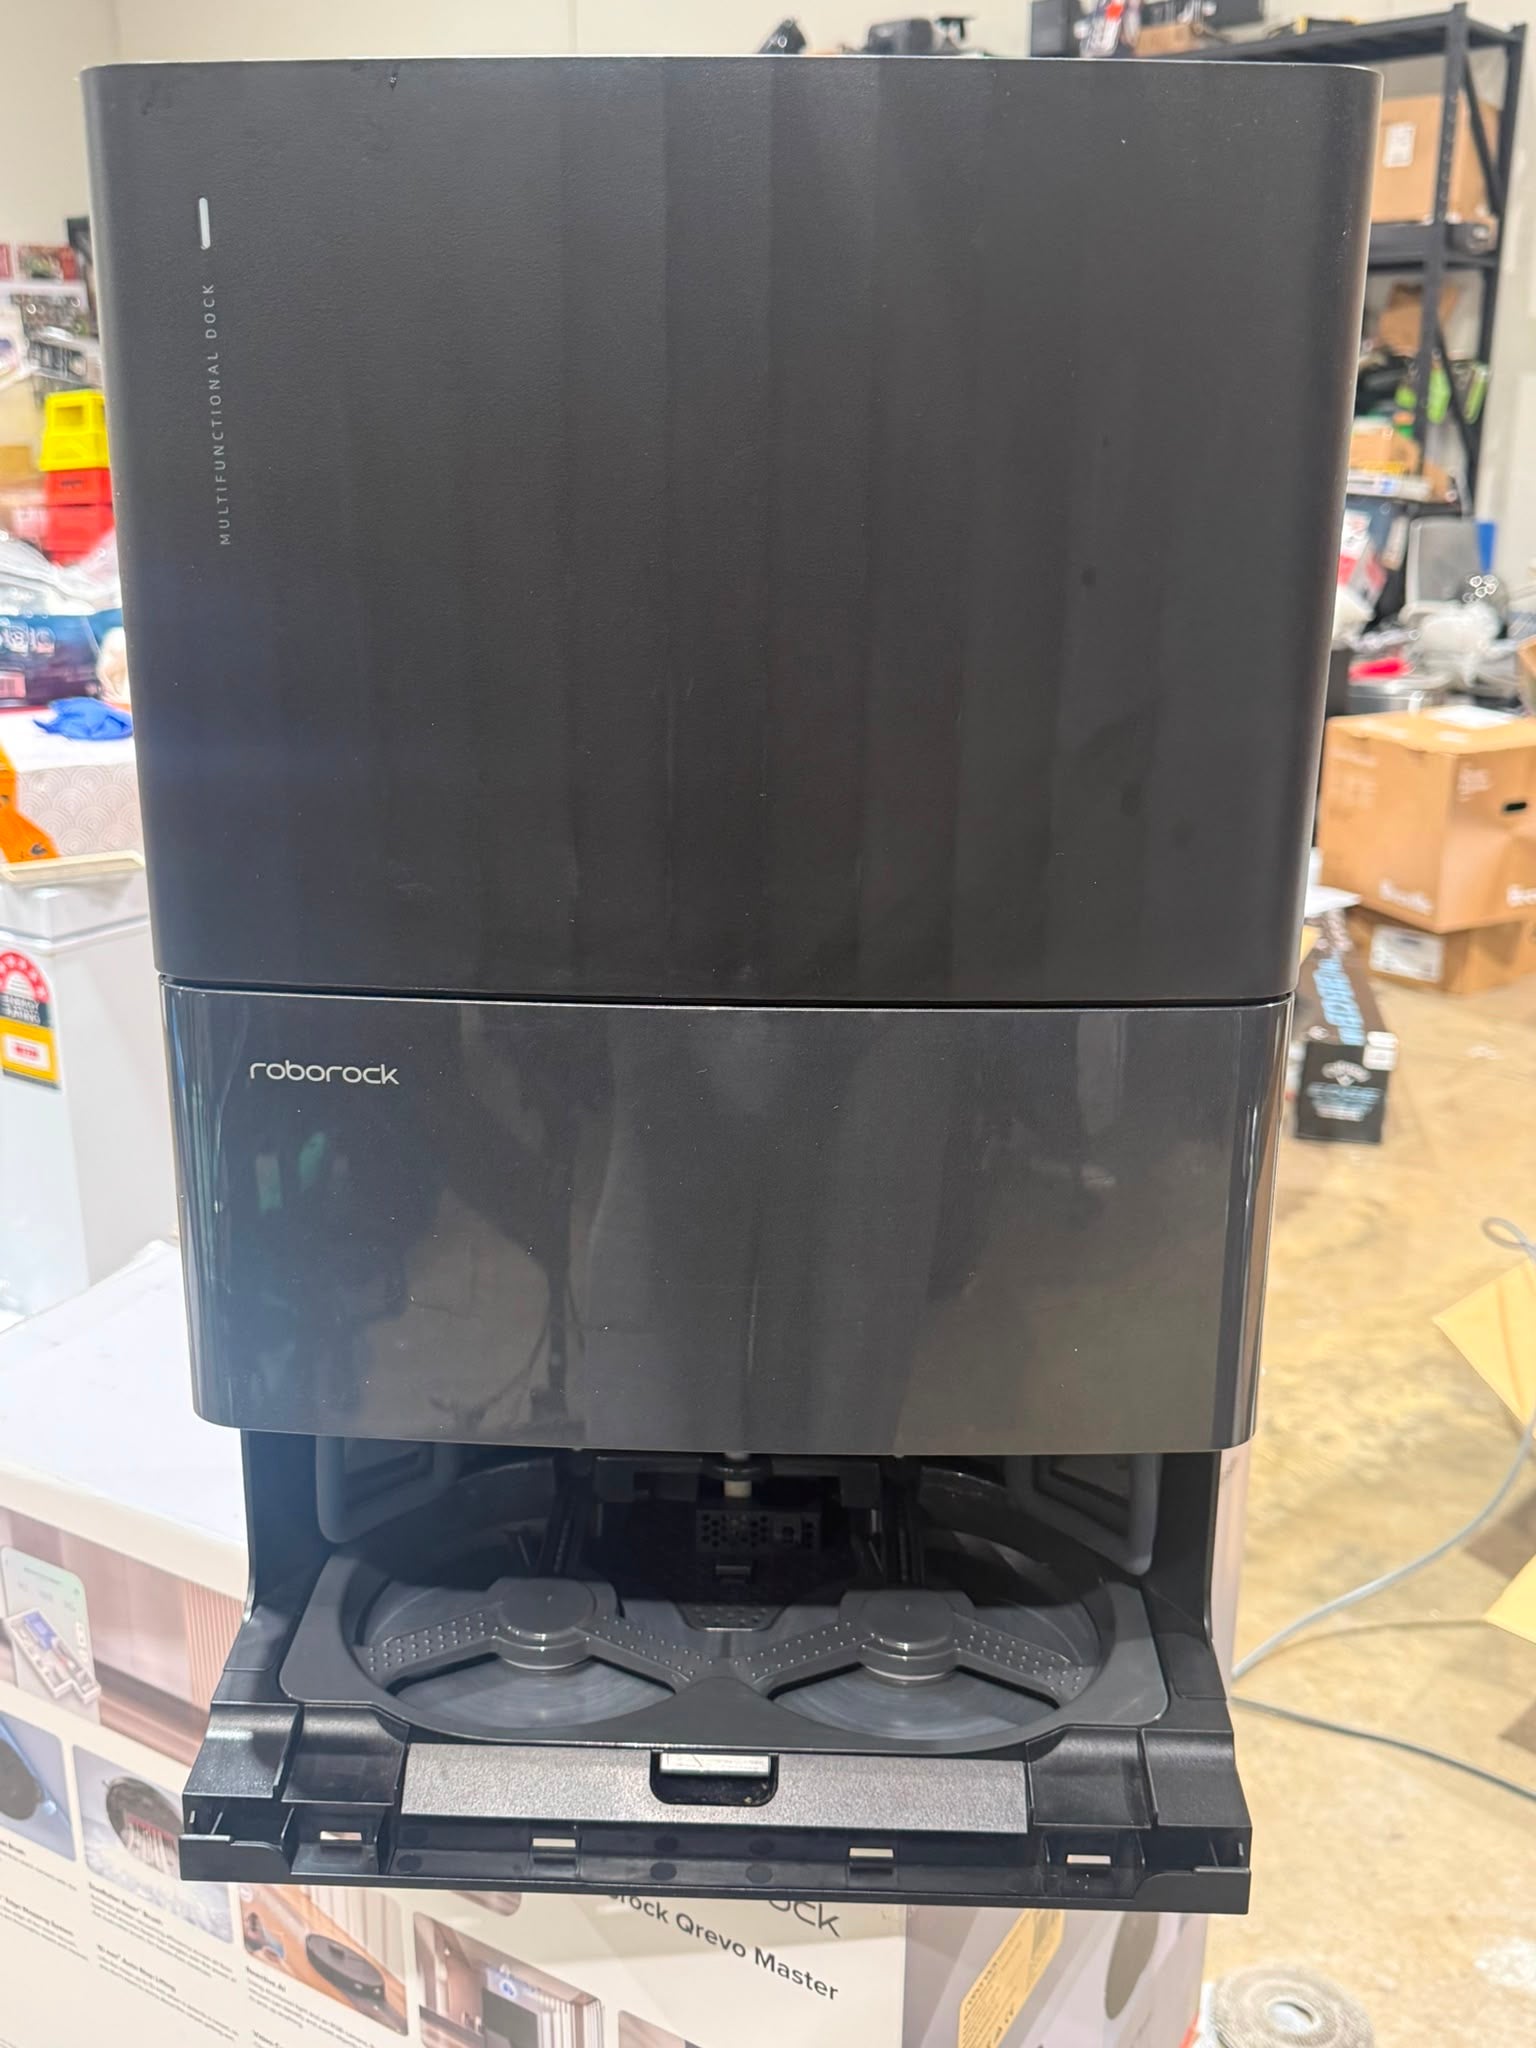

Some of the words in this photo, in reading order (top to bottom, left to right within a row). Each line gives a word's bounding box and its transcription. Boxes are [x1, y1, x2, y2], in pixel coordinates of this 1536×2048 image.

[202, 284, 217, 339] DOCK
[208, 352, 231, 545] MULTIFUNCTIONAL
[250, 1060, 399, 1085] roborock
[675, 1912, 747, 1958] Qrevo
[754, 1946, 839, 2000] Master
